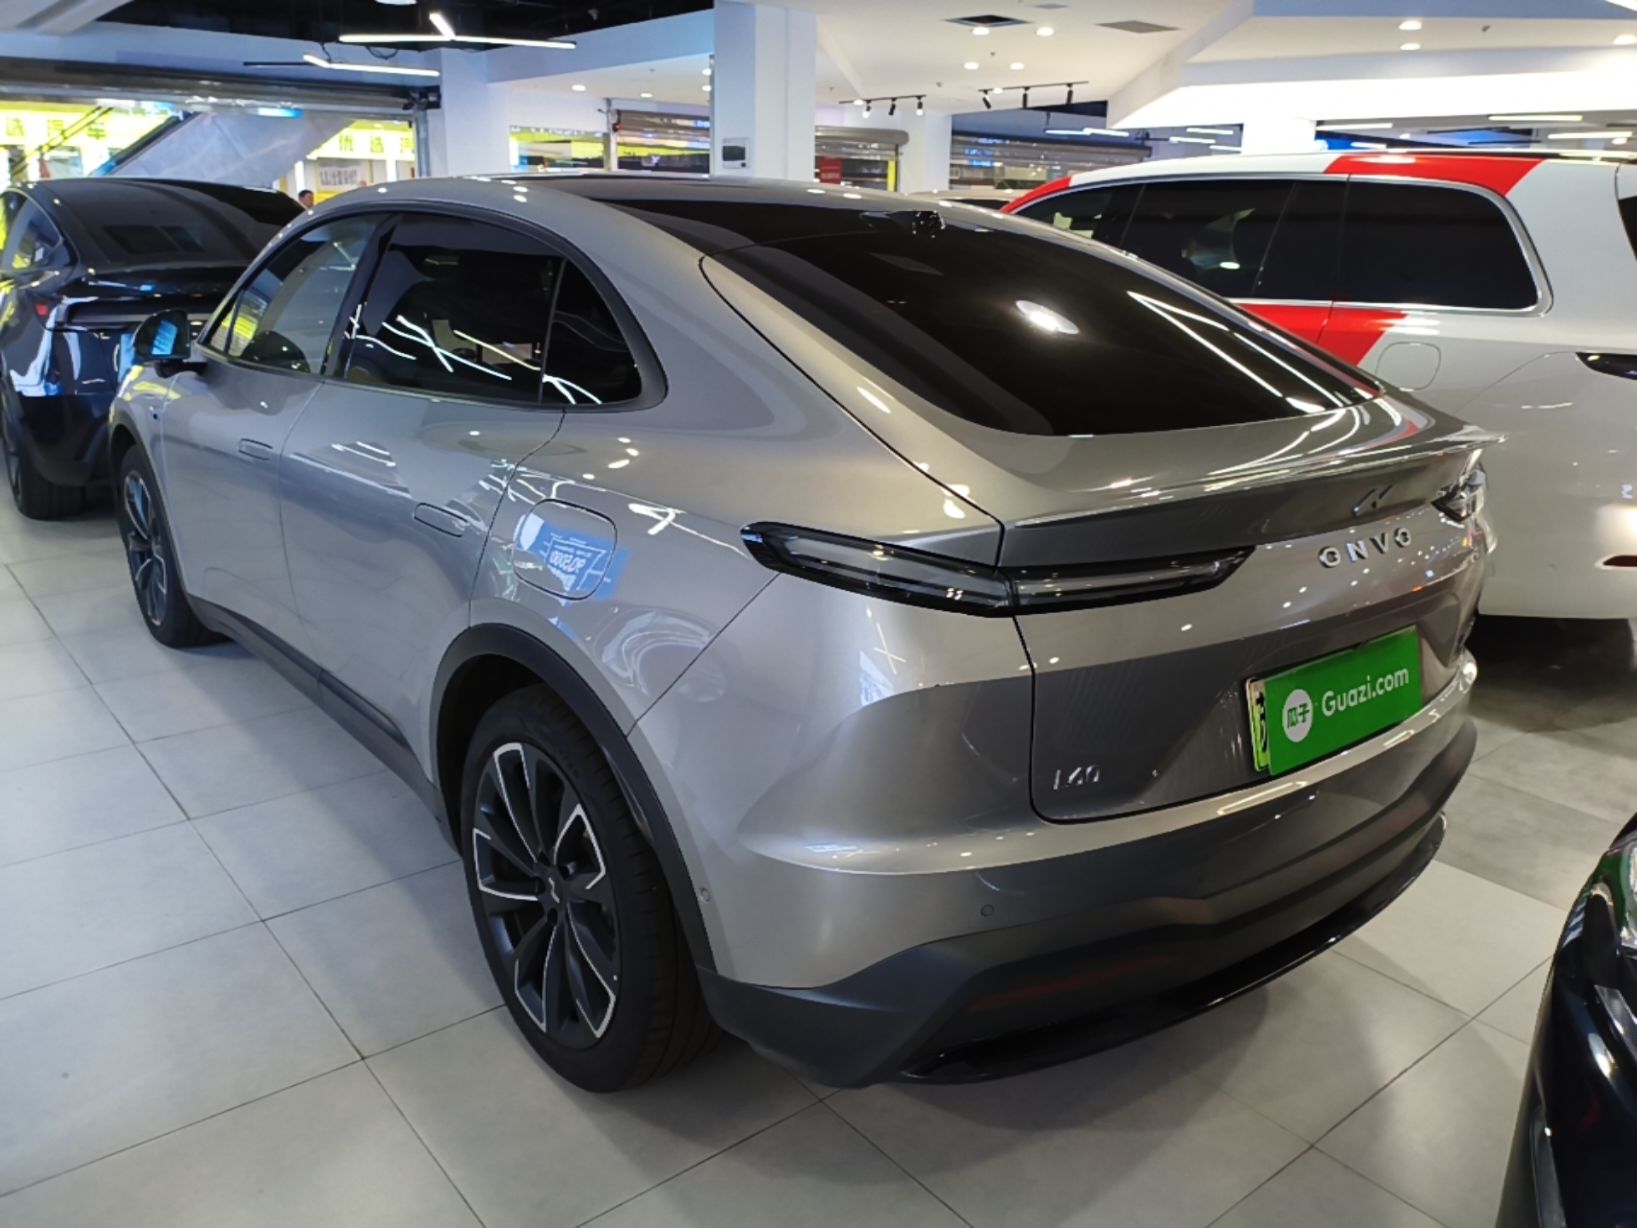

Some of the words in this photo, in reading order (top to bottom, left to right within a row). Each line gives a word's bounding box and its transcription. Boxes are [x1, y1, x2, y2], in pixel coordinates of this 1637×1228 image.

[1318, 526, 1412, 568] ONVO
[1321, 666, 1410, 717] Guazi.com
[1286, 702, 1311, 729] 瓜子
